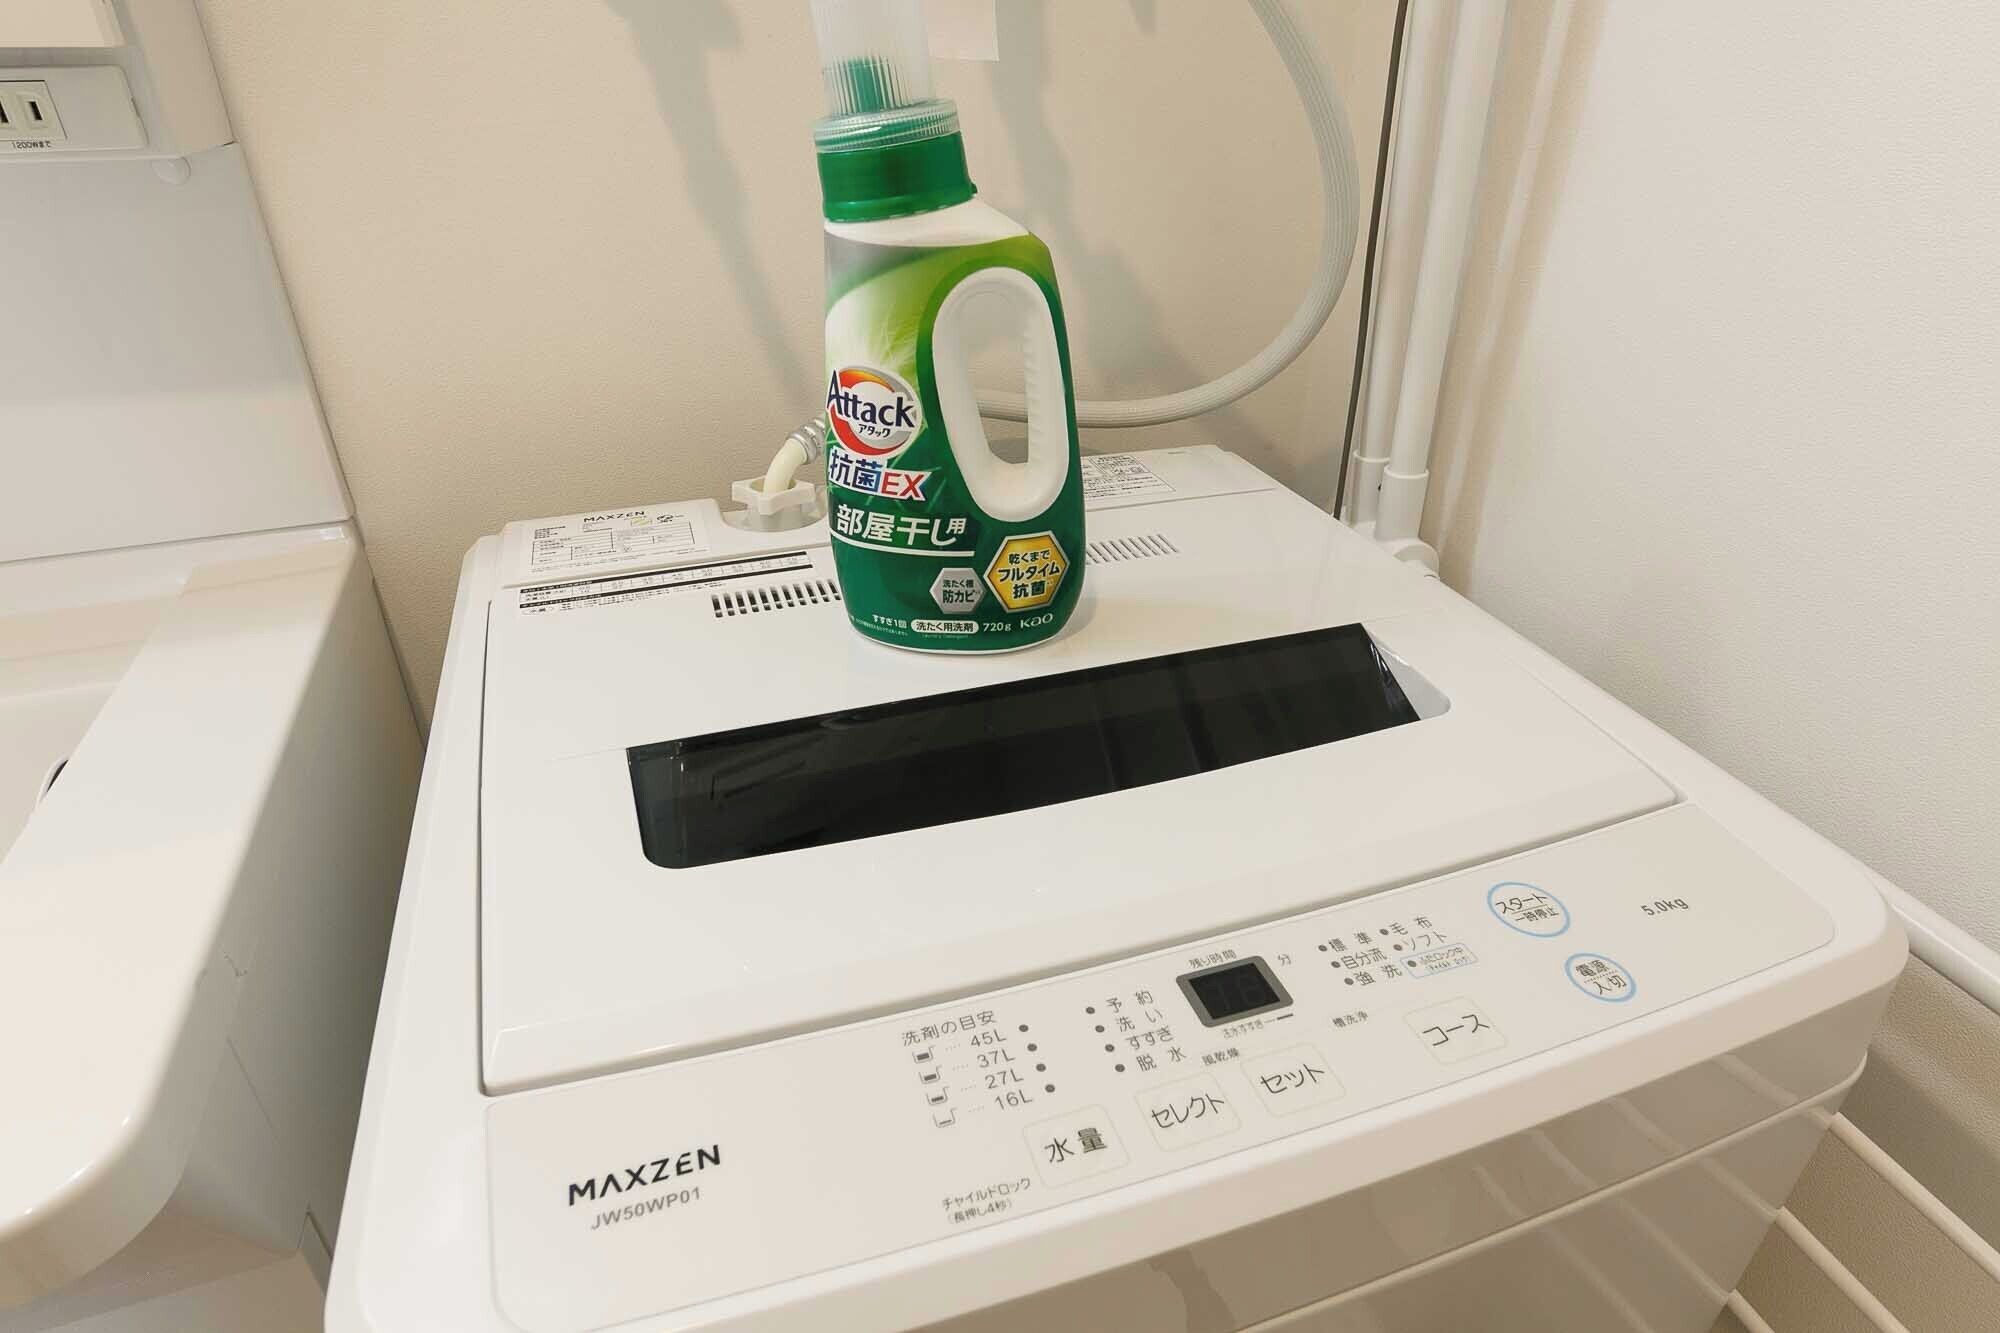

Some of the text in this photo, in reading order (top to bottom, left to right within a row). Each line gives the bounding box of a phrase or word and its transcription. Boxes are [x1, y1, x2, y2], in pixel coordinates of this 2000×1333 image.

[826, 369, 916, 428] Attack
[857, 423, 891, 438] アタック
[829, 452, 926, 500] 抗菌EX
[583, 511, 646, 523] MAXZEN
[836, 503, 967, 546] 部屋干し用
[1008, 549, 1050, 565] 乾くまで
[998, 562, 1060, 582] フルタイム
[943, 589, 975, 604] 防カビ
[1013, 581, 1046, 599] 抗菌
[916, 621, 974, 633] 洗たく用洗剤
[982, 621, 1012, 633] 720g
[1495, 893, 1547, 914] スタート
[1515, 906, 1560, 922] 一時停止
[1640, 898, 1689, 916] 5.0kg
[1277, 953, 1292, 966] 分
[1340, 930, 1447, 970] 自分流 ソフト
[1575, 959, 1610, 977] 電源
[1106, 989, 1154, 1013] 予約
[901, 1010, 997, 1047] 洗剤の目安
[1116, 1009, 1164, 1032] 洗い
[1421, 1013, 1491, 1047] コース
[970, 1028, 1008, 1049] 45L
[1125, 1026, 1174, 1050] すすぎ
[976, 1048, 1016, 1070] 37L
[1136, 1045, 1187, 1072] 脱水
[984, 1068, 1025, 1090] 27L
[1260, 1062, 1326, 1095] セット
[993, 1089, 1034, 1111] 16L
[1151, 1092, 1226, 1130] セレクト
[1043, 1126, 1108, 1164] 水量
[568, 1144, 721, 1207] MAXZEN
[942, 1177, 1031, 1211] チャイルドロック
[590, 1185, 702, 1231] JW50WP01
